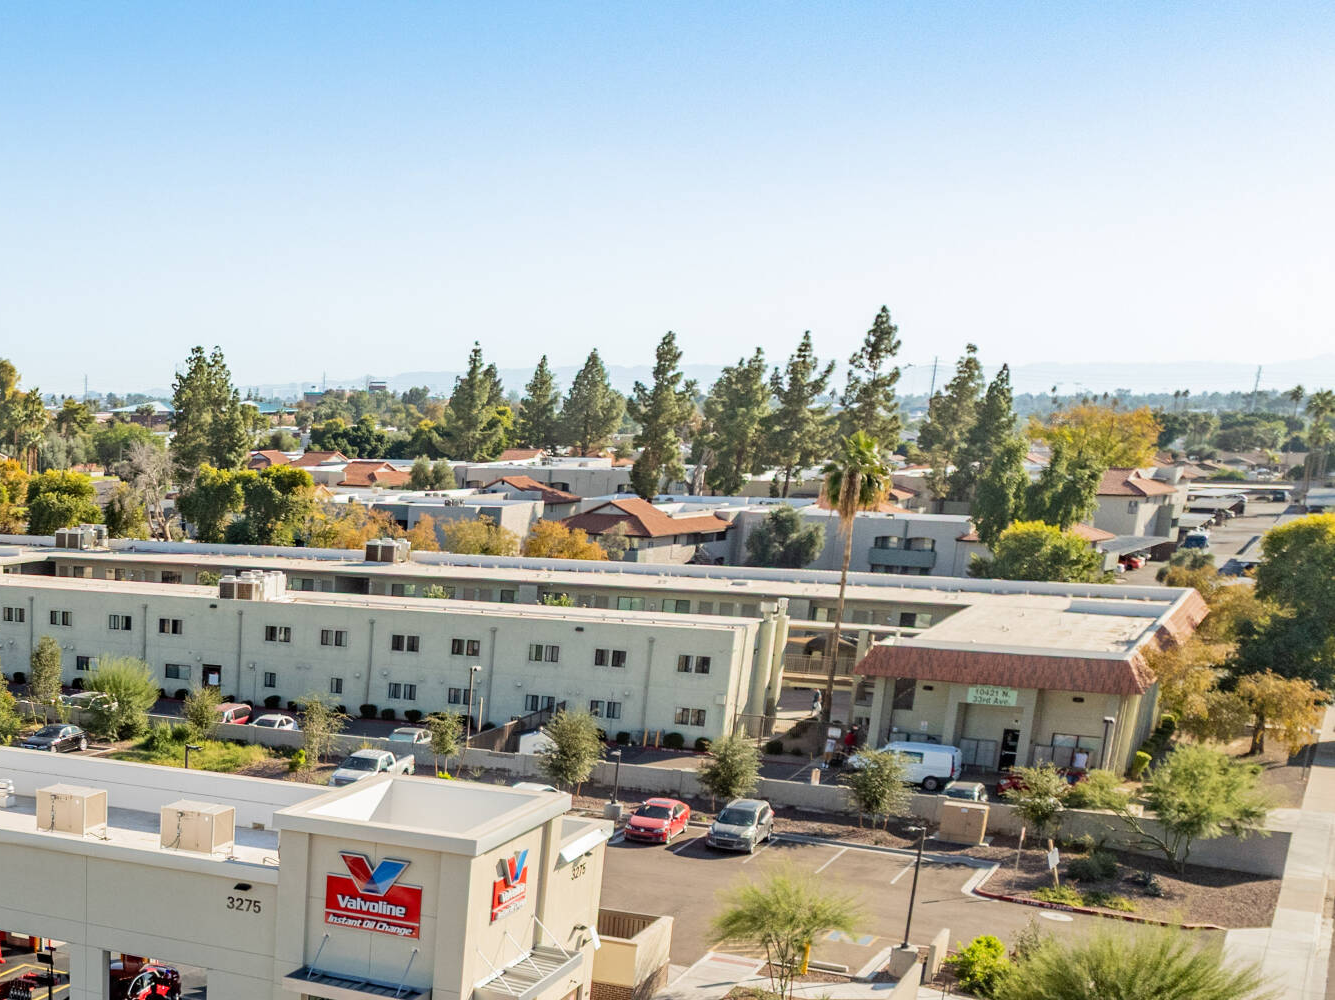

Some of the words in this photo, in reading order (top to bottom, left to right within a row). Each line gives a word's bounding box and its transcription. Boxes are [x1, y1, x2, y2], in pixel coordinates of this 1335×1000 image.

[571, 862, 586, 880] 3275
[226, 896, 262, 914] 3275
[336, 894, 406, 918] Valvoline
[328, 914, 362, 928] Instant
[362, 920, 377, 929] Oil
